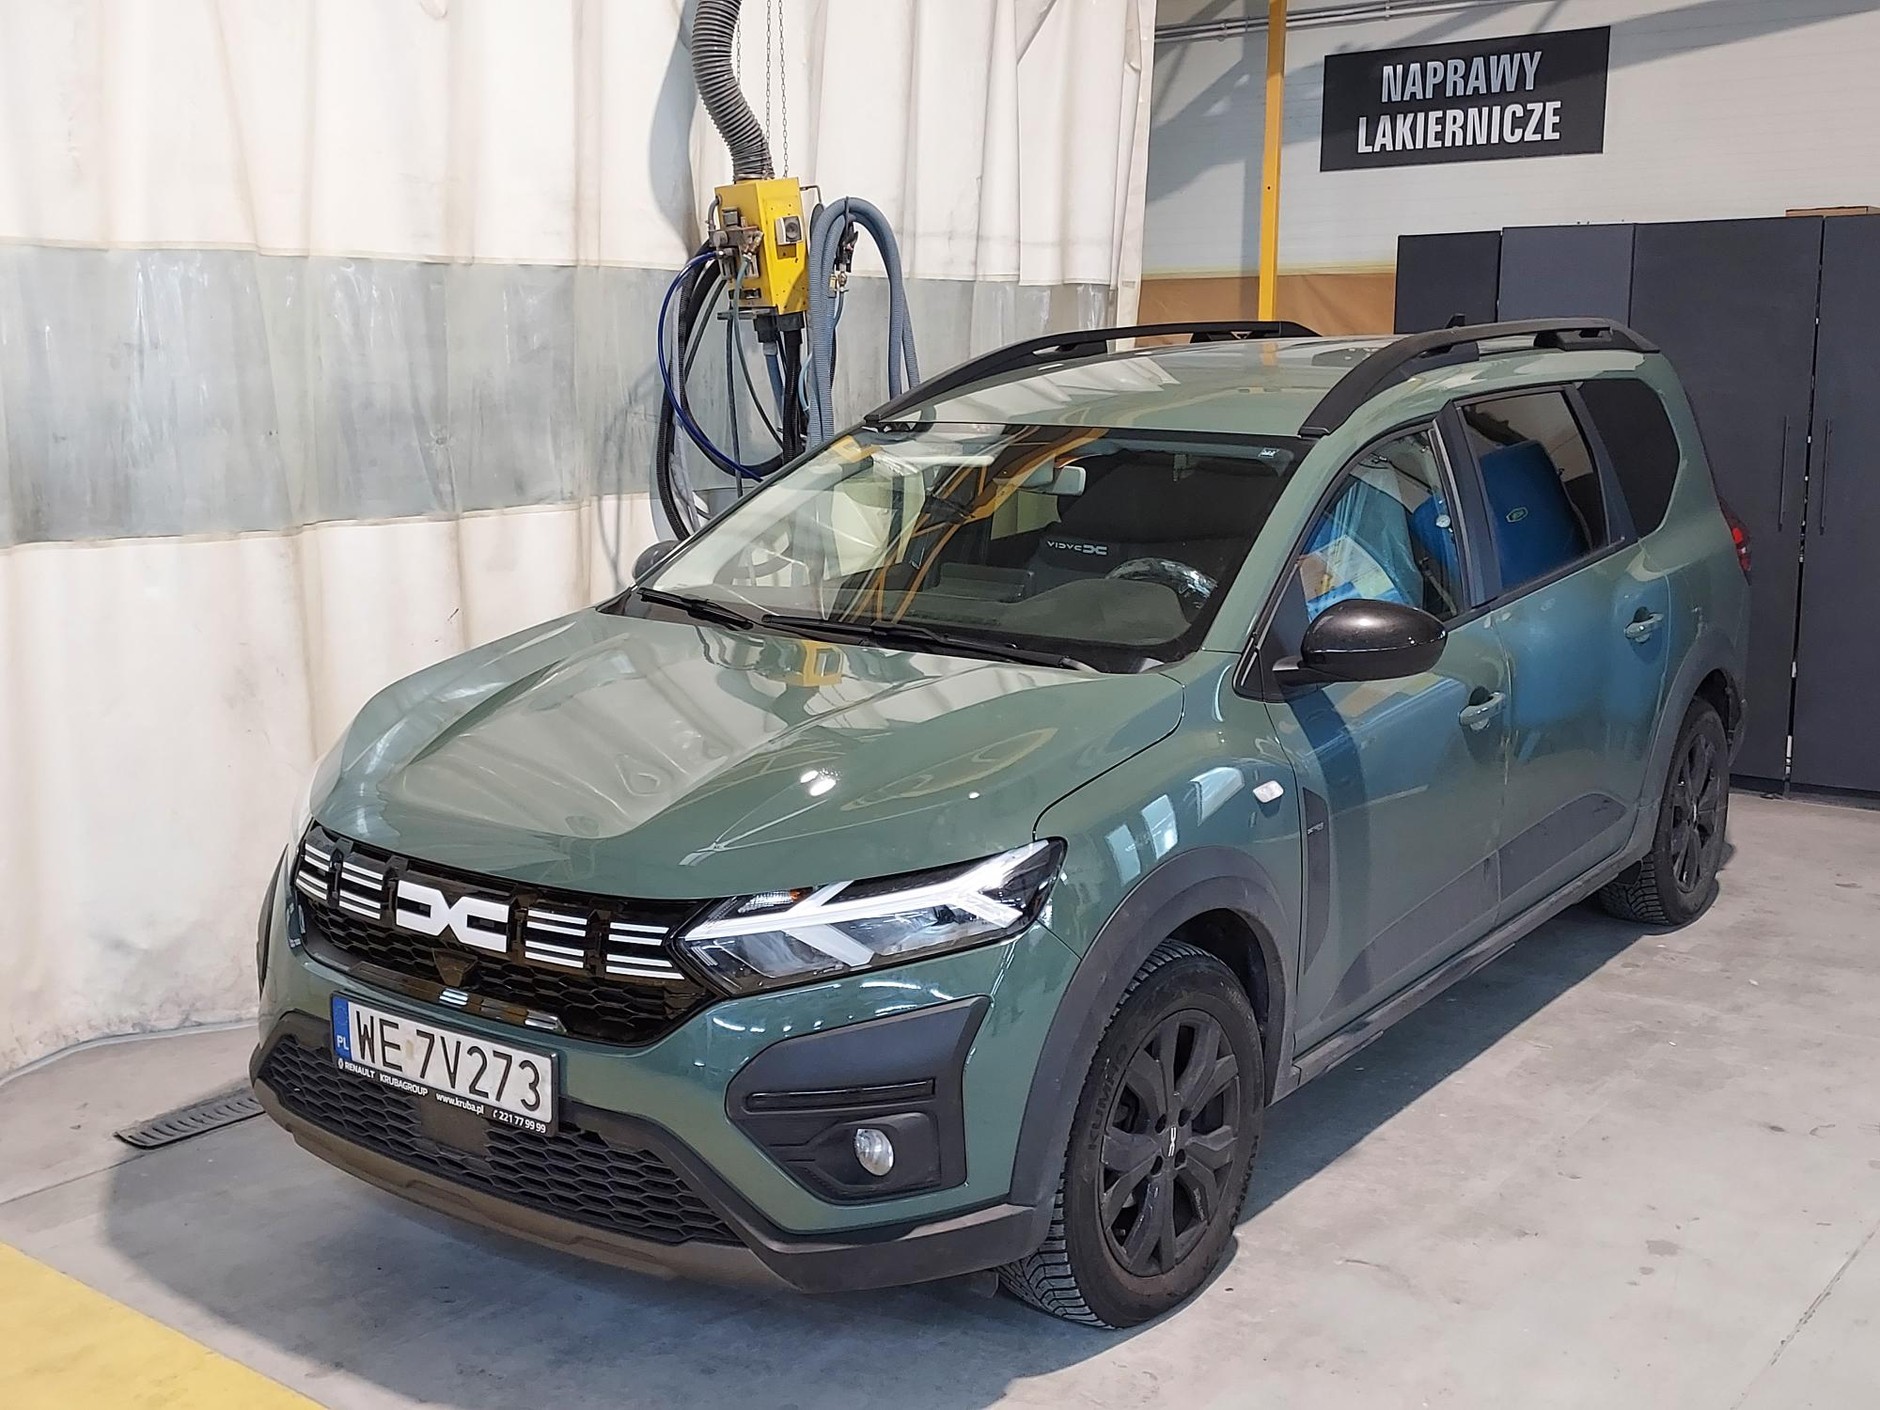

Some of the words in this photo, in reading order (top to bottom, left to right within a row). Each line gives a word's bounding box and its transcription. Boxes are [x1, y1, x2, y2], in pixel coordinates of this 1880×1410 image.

[1381, 51, 1543, 103] NAPRAWY
[1357, 101, 1562, 154] LAKIERNICZE
[337, 1036, 349, 1050] PL
[356, 1010, 403, 1072] WE
[416, 1029, 541, 1111] 7V273
[344, 1061, 376, 1079] RENAULT
[379, 1073, 428, 1097] KRUBAGROUP
[435, 1092, 484, 1115] www.kruba.pl
[499, 1110, 513, 1123] 221
[514, 1115, 524, 1127] 77
[524, 1119, 535, 1131] 99
[536, 1123, 546, 1135] 99
